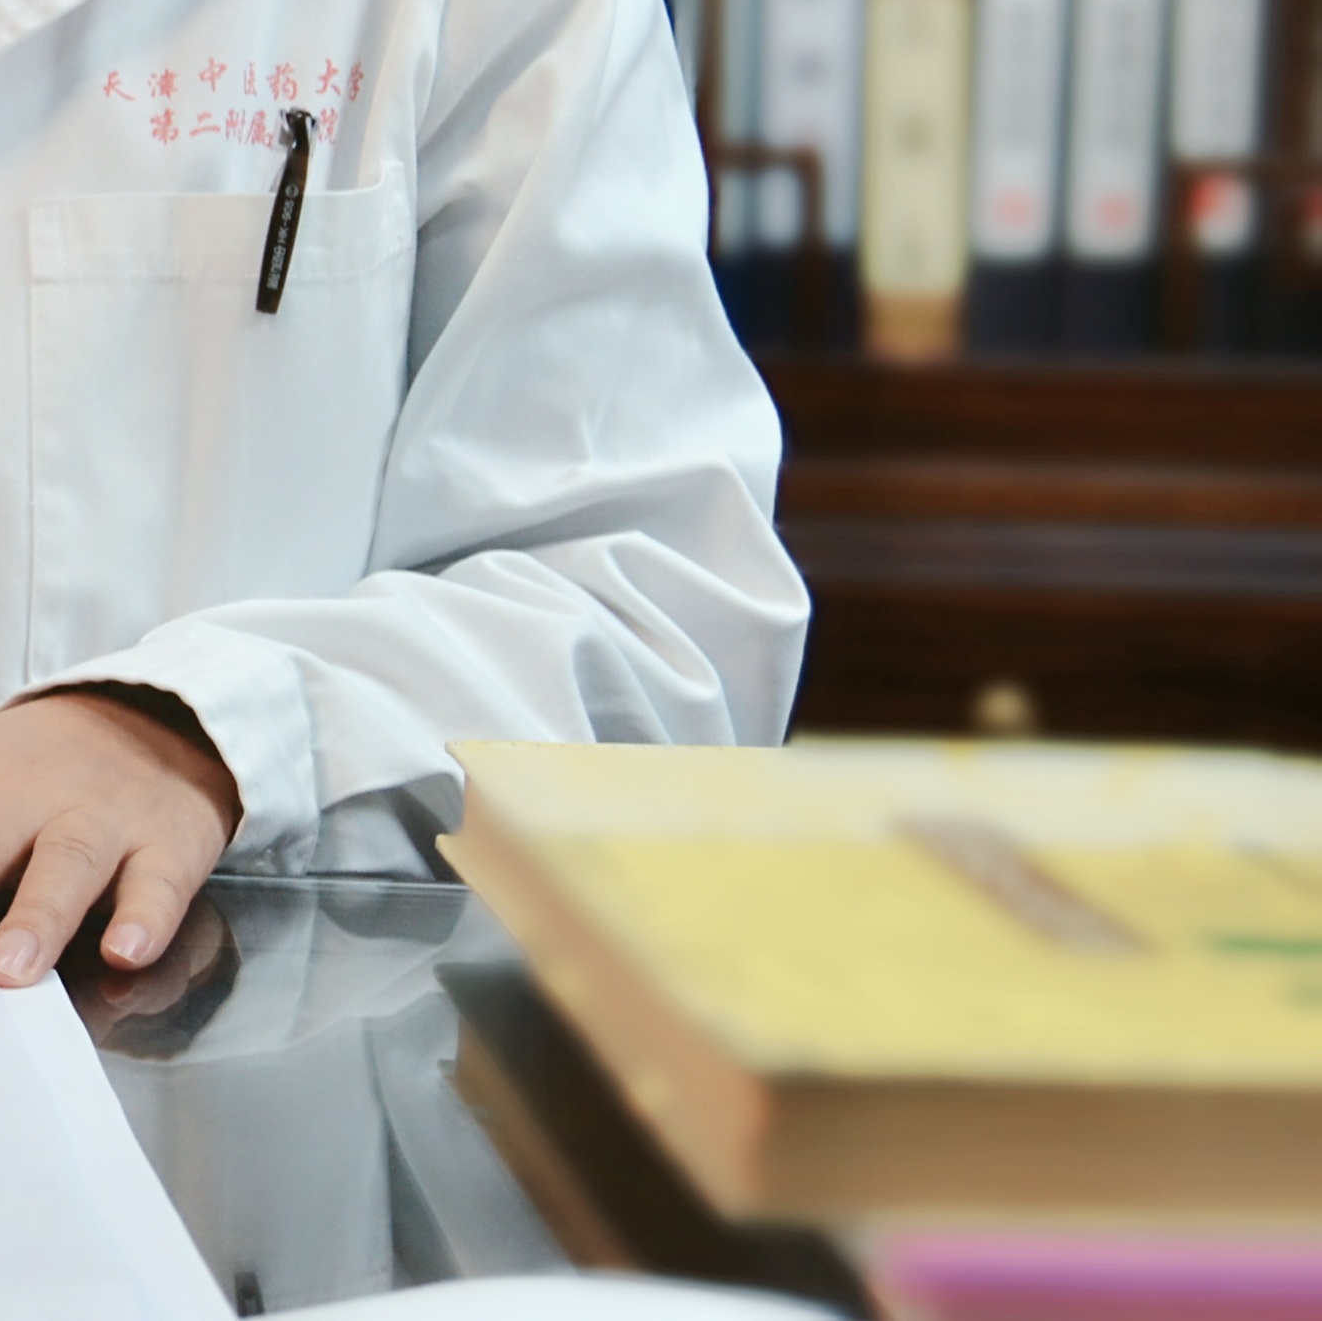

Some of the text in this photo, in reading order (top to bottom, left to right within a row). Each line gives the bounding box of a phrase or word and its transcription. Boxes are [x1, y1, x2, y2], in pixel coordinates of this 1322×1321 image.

[150, 108, 339, 148] 第二附属院
